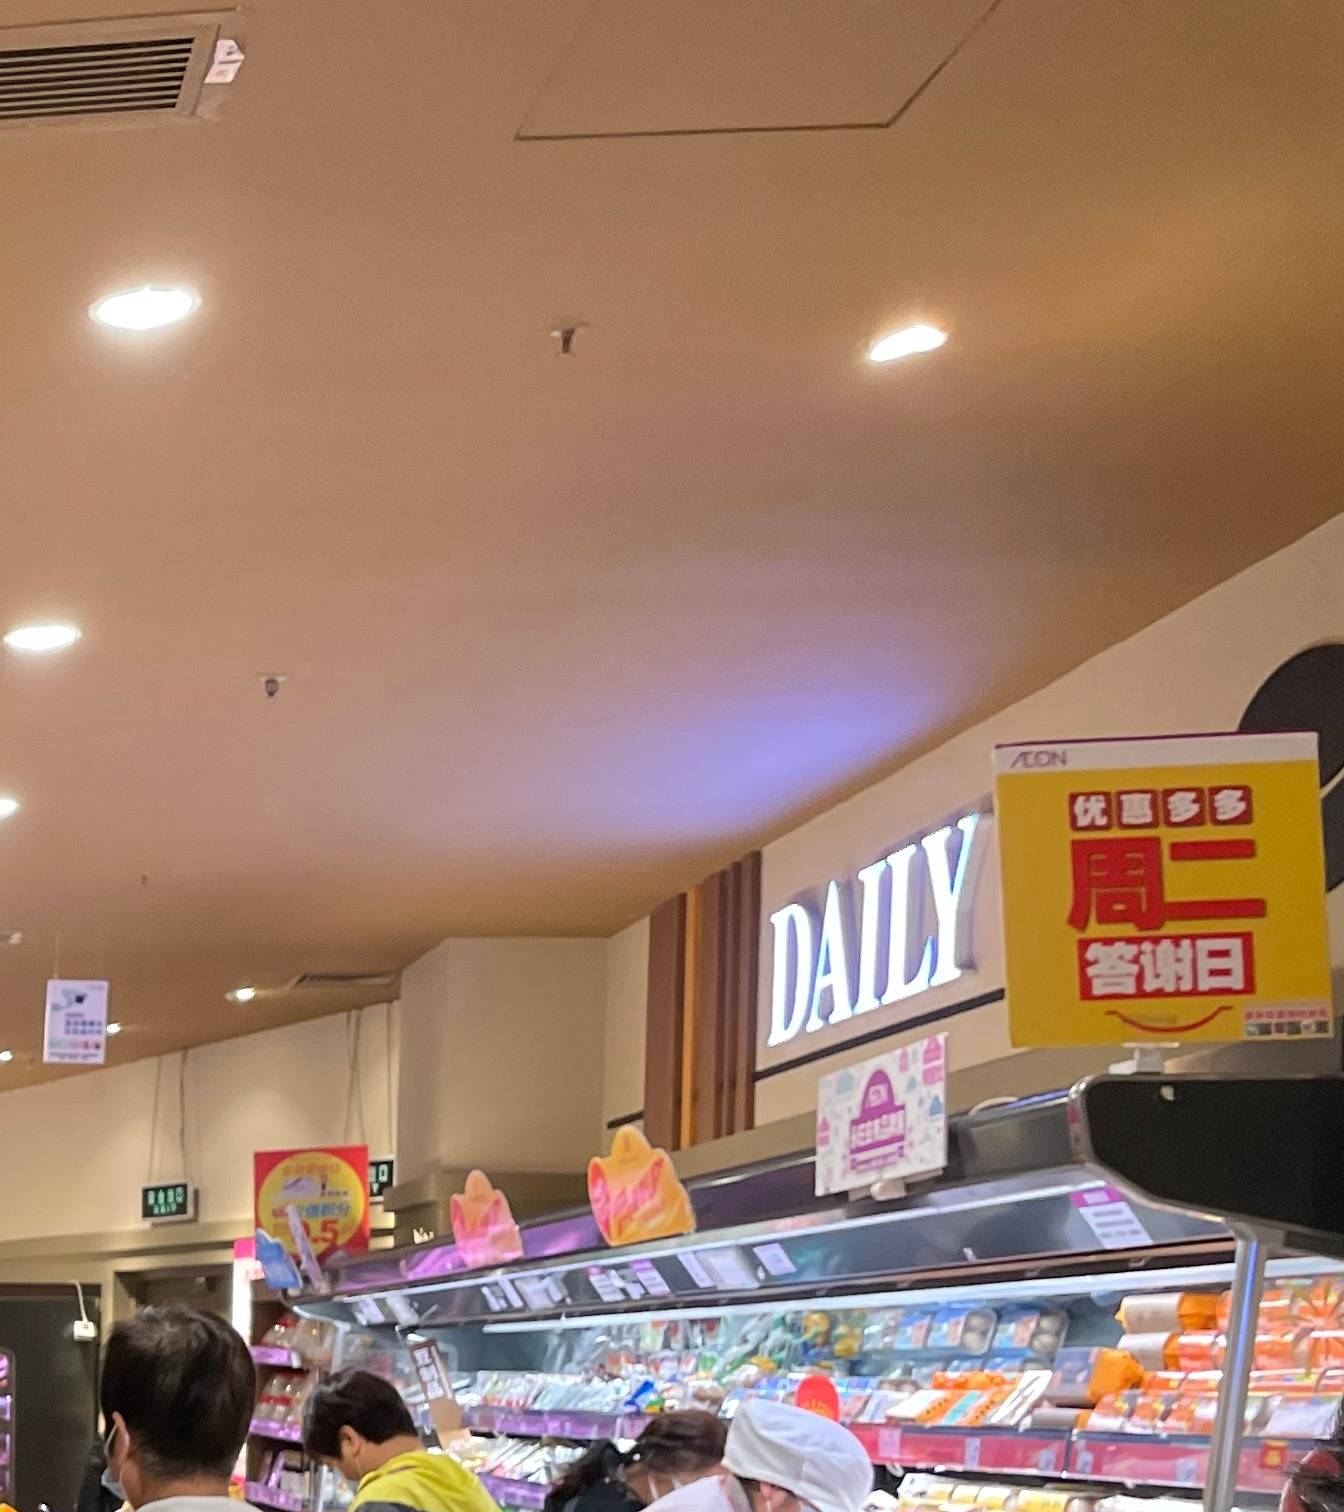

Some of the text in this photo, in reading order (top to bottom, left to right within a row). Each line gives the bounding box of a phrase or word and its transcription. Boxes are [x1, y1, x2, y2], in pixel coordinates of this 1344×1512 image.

[1073, 786, 1249, 827] 优惠多多
[1067, 837, 1267, 931] 周二
[767, 811, 981, 1048] DAILY
[1085, 942, 1249, 994] 答谢日
